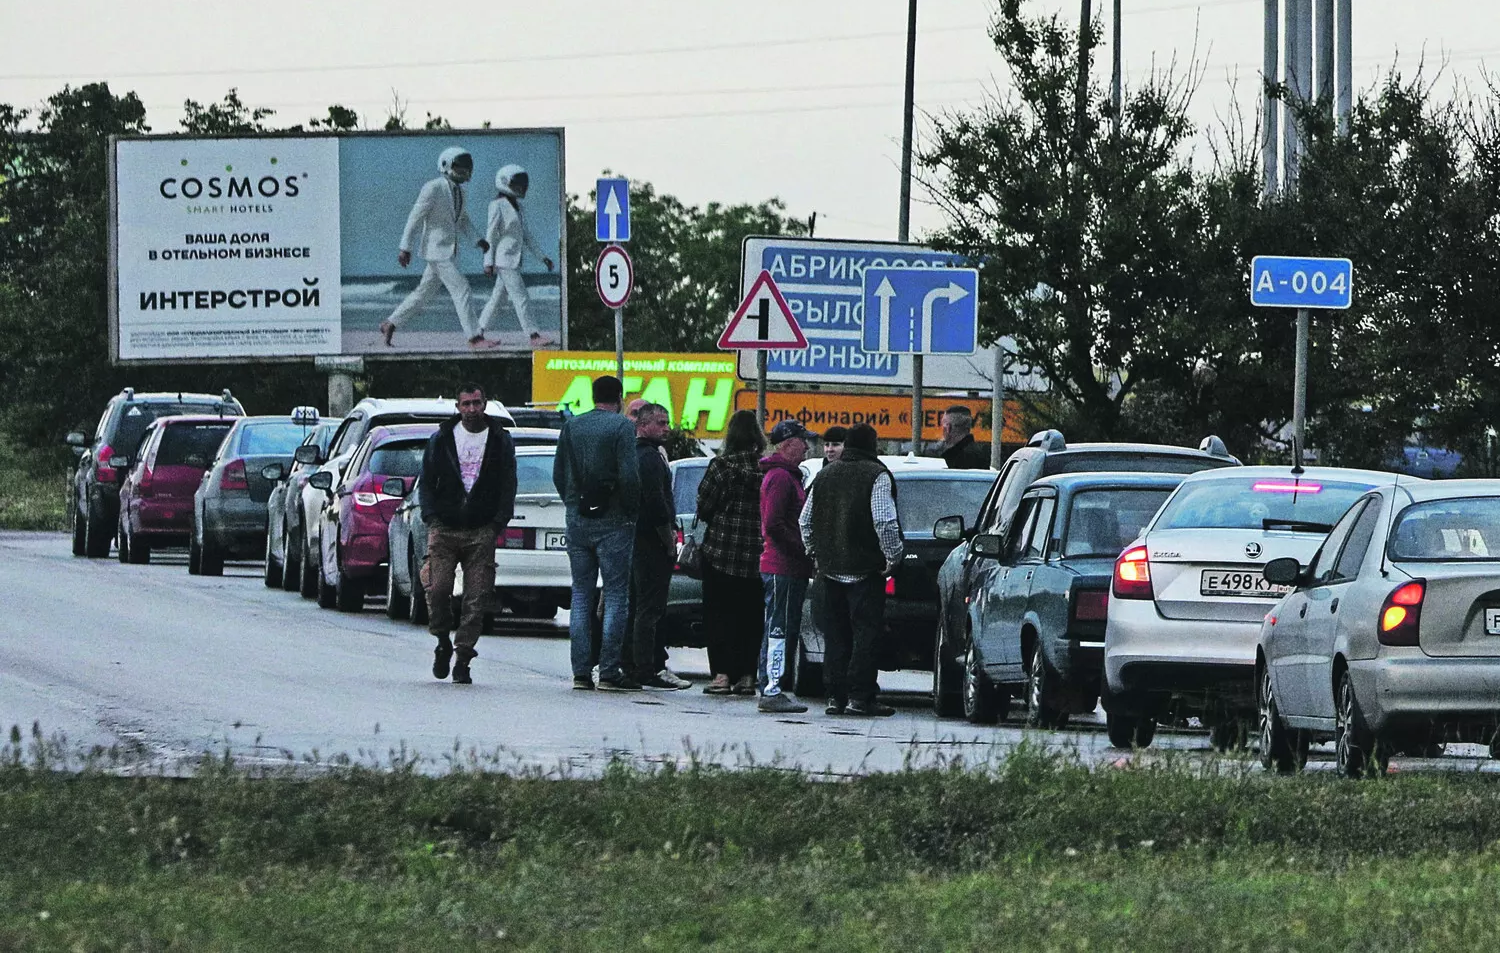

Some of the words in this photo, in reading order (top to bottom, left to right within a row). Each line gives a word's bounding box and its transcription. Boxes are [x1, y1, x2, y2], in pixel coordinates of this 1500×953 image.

[159, 175, 300, 199] COSMOS
[186, 205, 225, 214] SMART
[229, 204, 274, 214] HOTELS
[185, 233, 228, 245] ВАША
[230, 232, 271, 245] ДОЛЯ
[148, 249, 158, 261] В
[161, 248, 242, 261] ОТЕЛЬНОМ
[245, 247, 311, 259] БИЗНЕСЕ
[608, 264, 620, 289] 5
[139, 277, 321, 311] ИНТЕРСТРОЙ
[546, 358, 666, 372] АВТОЗАПРАОЧНЫЙ
[667, 359, 735, 373] КОМПЛЕКС
[753, 405, 891, 427] ельфинарий
